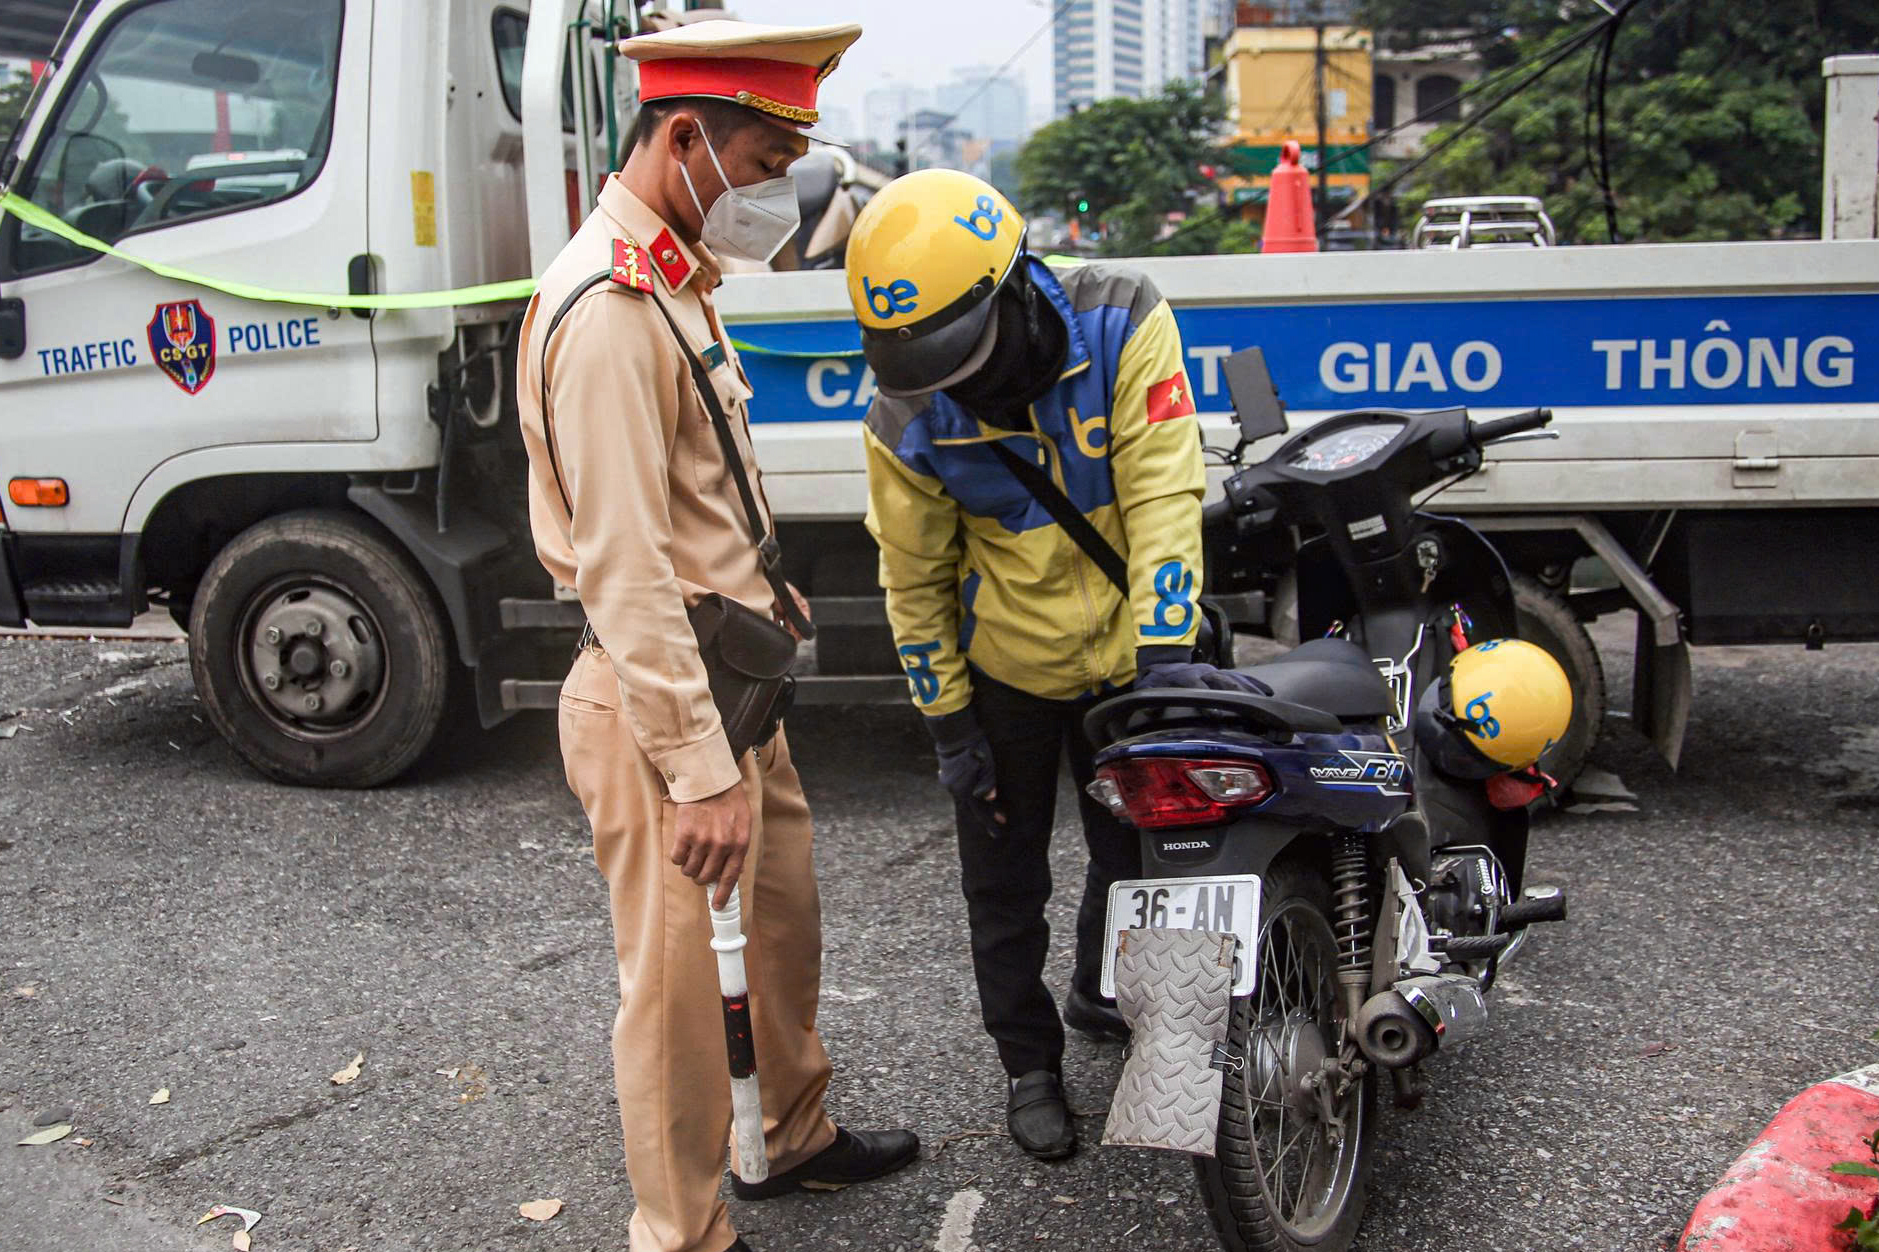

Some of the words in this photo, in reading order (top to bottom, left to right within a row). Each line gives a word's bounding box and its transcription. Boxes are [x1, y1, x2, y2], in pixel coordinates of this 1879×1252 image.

[954, 195, 1003, 241] be
[863, 276, 919, 319] be
[38, 339, 137, 375] TRAFFIC
[228, 318, 321, 353] POLICE
[1319, 341, 1502, 393] GIAO
[1592, 320, 1854, 390] THÔNG
[1140, 562, 1193, 637] be
[1310, 767, 1360, 779] WAVE
[1163, 840, 1211, 850] HONDA
